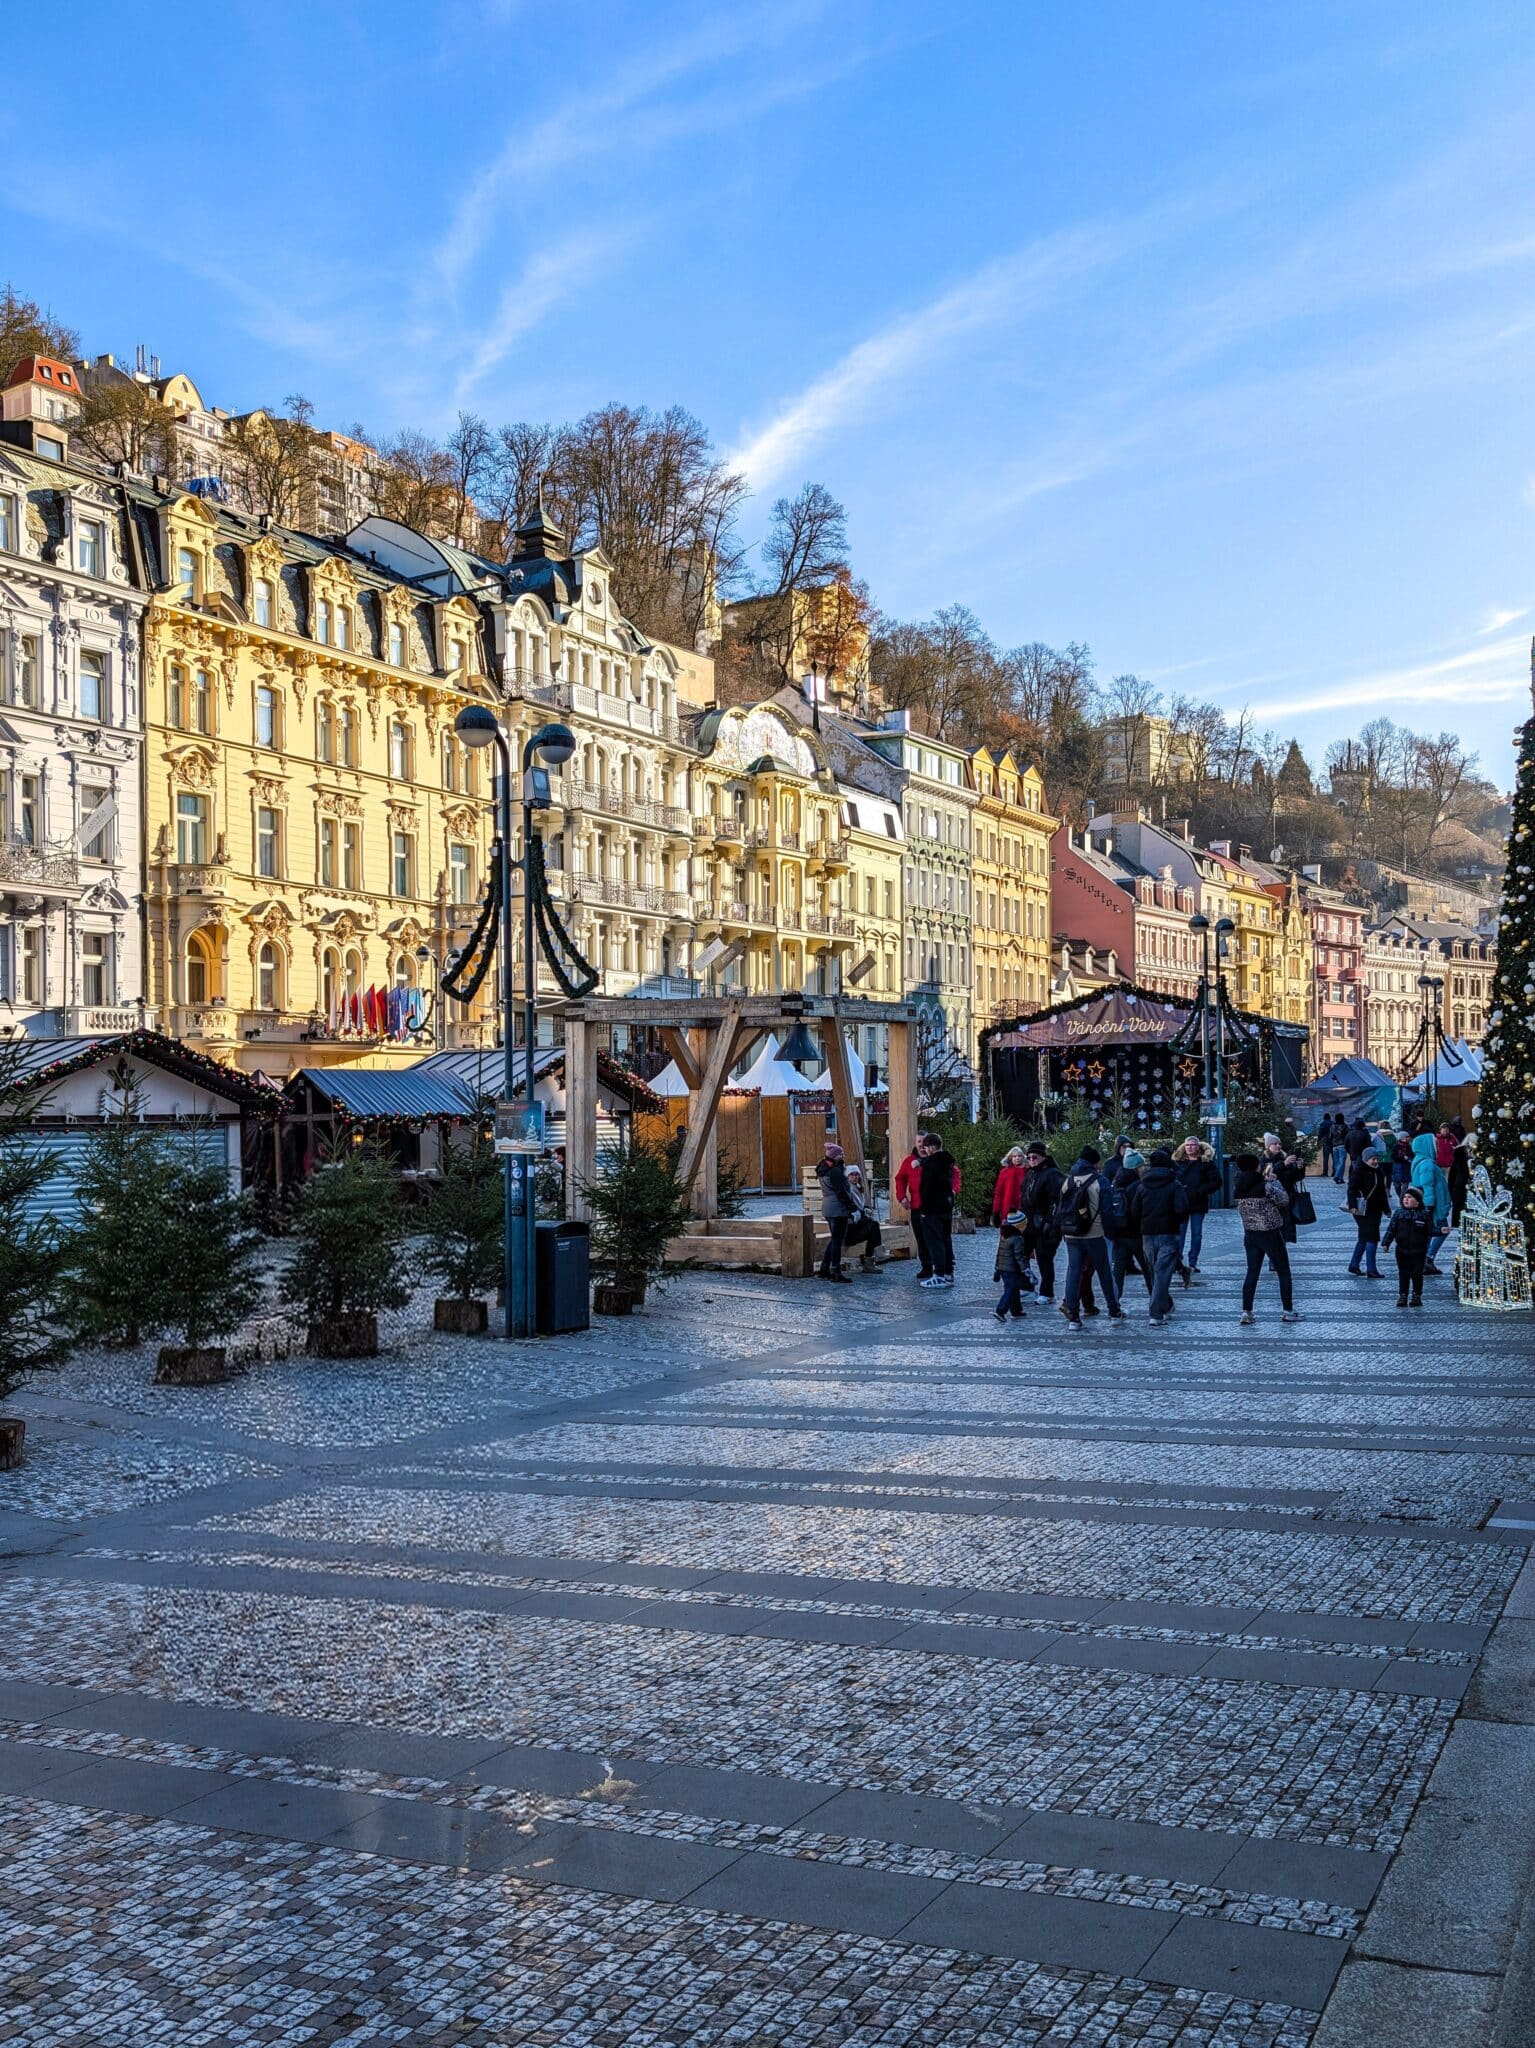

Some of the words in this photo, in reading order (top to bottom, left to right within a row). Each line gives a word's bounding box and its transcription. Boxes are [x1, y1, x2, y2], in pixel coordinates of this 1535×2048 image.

[1064, 867, 1119, 912] Salvator
[1066, 1020, 1125, 1035] Vánoční
[1128, 1017, 1167, 1036] Vary
[287, 1055, 392, 1070] ASTORIA
